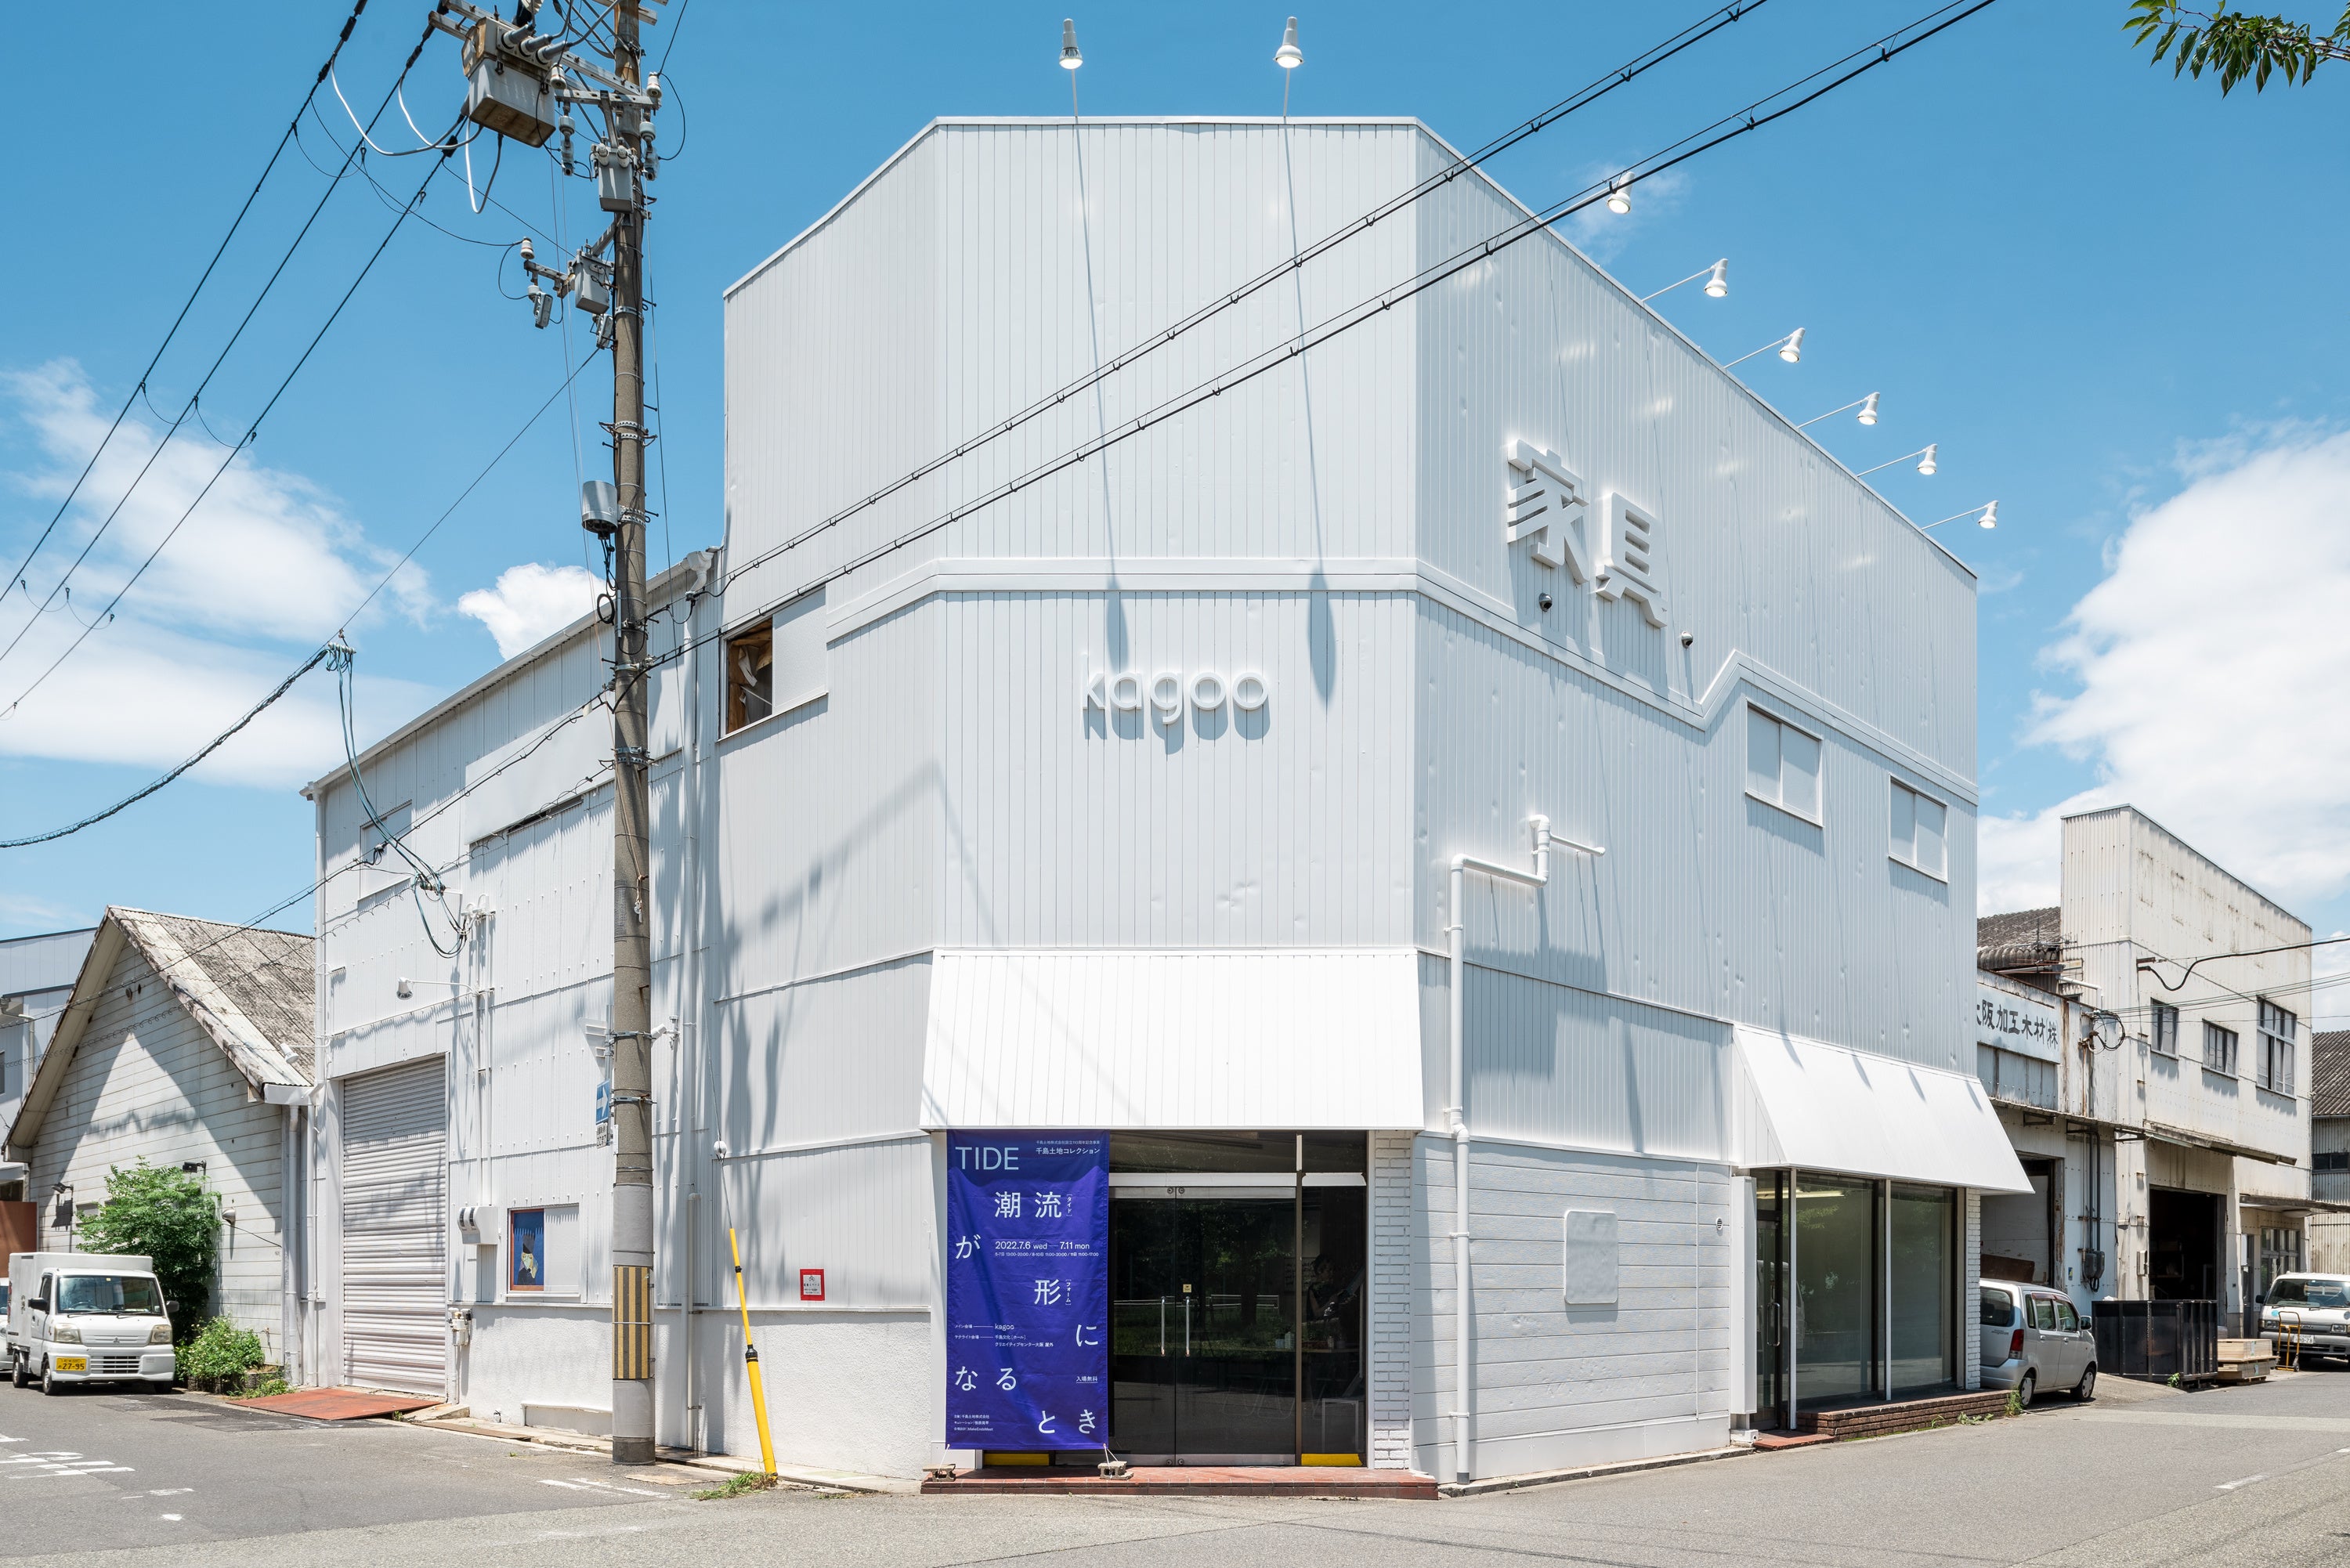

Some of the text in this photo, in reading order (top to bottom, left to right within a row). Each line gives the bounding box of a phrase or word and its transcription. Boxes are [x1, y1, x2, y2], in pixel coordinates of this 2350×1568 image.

[1081, 653, 1270, 725] kagoo
[955, 1147, 1019, 1170] TIDE
[1036, 1147, 1101, 1155] 千島土地コレクション
[994, 1190, 1062, 1219] 潮流
[956, 1234, 982, 1259] が
[995, 1241, 1031, 1250] 2022.7.6
[1059, 1241, 1073, 1250] 7.11
[1034, 1278, 1061, 1306] 形
[1076, 1324, 1098, 1347] に
[955, 1366, 1017, 1391] なる
[1038, 1409, 1096, 1434] とき
